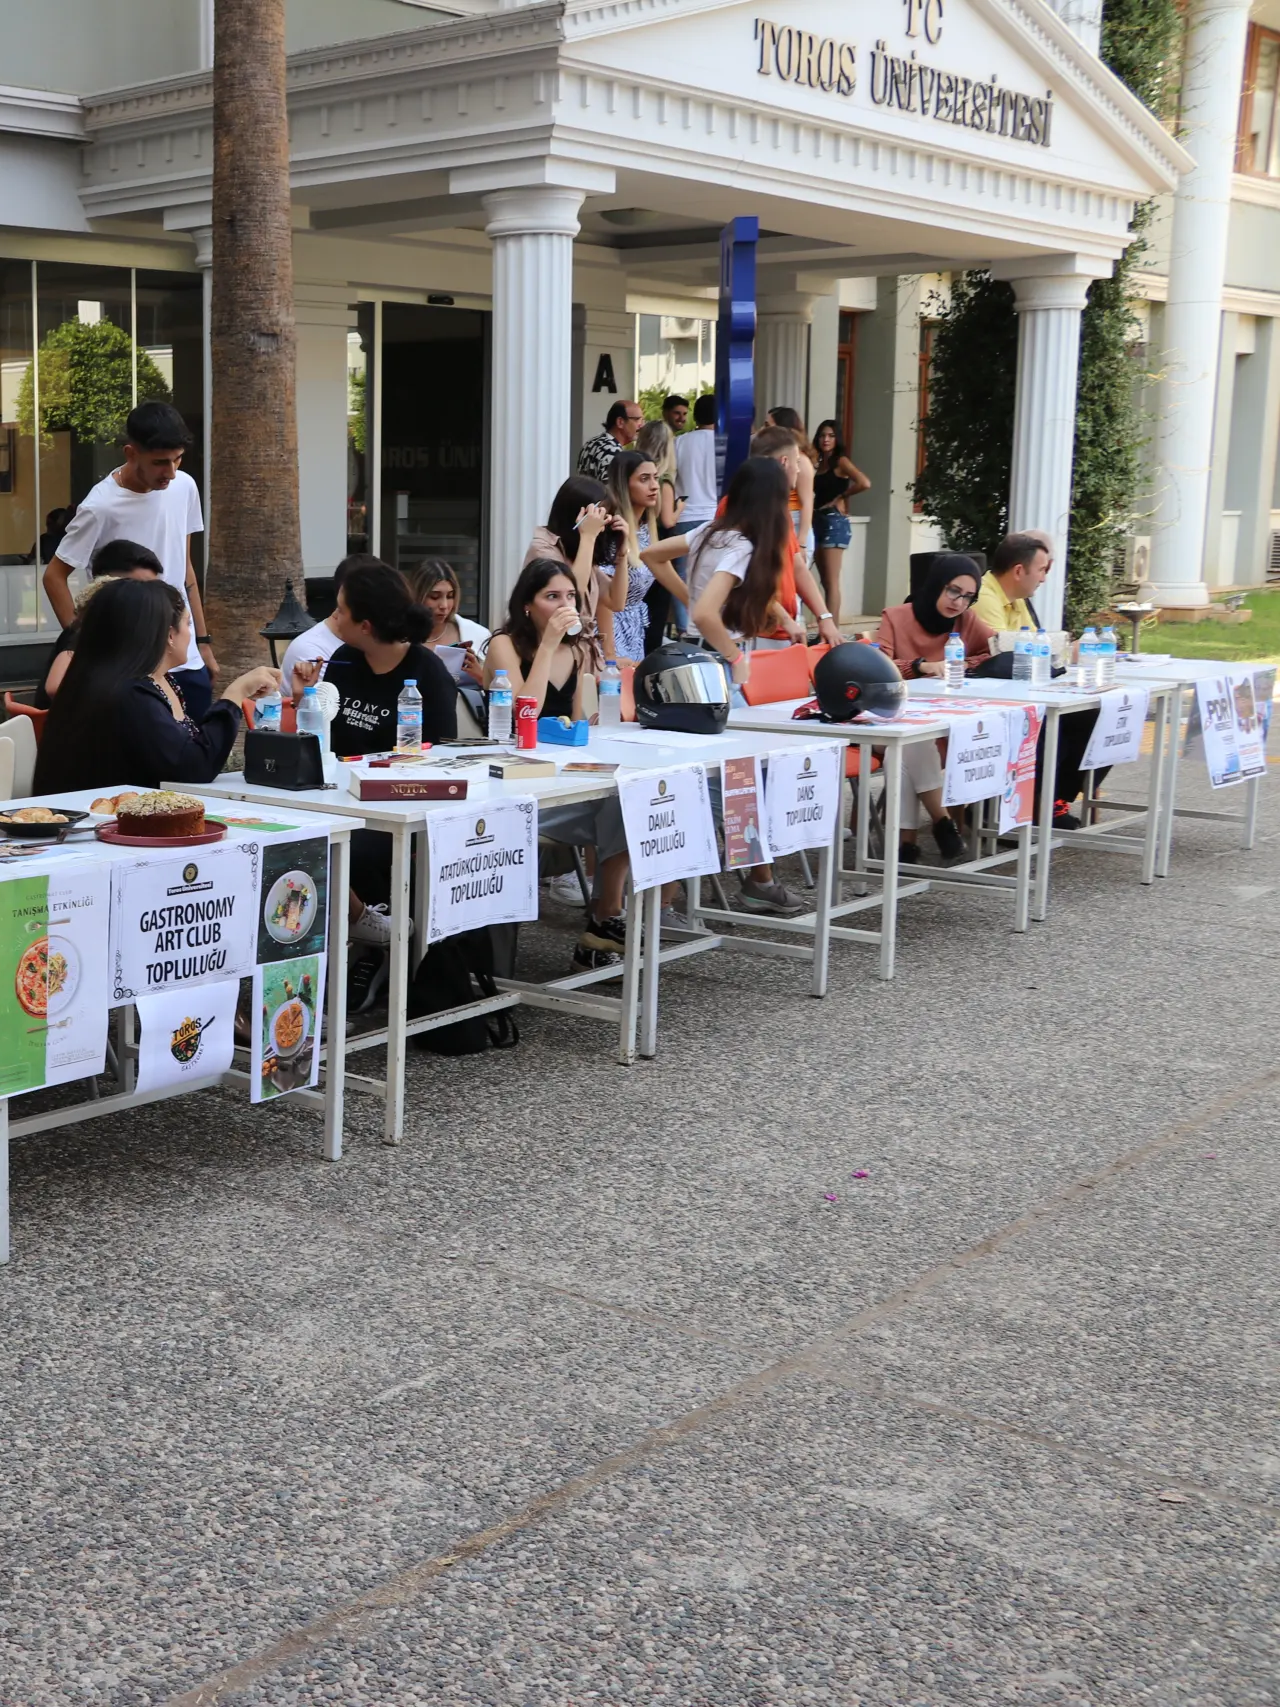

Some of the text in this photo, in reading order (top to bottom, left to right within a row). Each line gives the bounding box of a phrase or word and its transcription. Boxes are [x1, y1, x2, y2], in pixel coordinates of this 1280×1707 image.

[754, 17, 1054, 148] TOROS ÜNİVERSİTESİ
[592, 353, 618, 393] A
[390, 784, 428, 793] NUTUK
[797, 785, 815, 803] DANS
[648, 813, 675, 832] DAMLA
[786, 803, 823, 827] TOPLULUĞU
[640, 830, 685, 857] TOPLULUĞU
[439, 848, 524, 882] ATATÜRKÇÜ DÜŞÜNCE
[450, 871, 504, 905] TOPLULUĞU
[53, 896, 94, 911] ETKİNLİĞİ
[140, 896, 235, 933] GASTRONOMY
[154, 922, 221, 953] ART CLUB
[146, 949, 226, 985] TOPLULUĞU
[173, 1017, 202, 1041] TOROS
